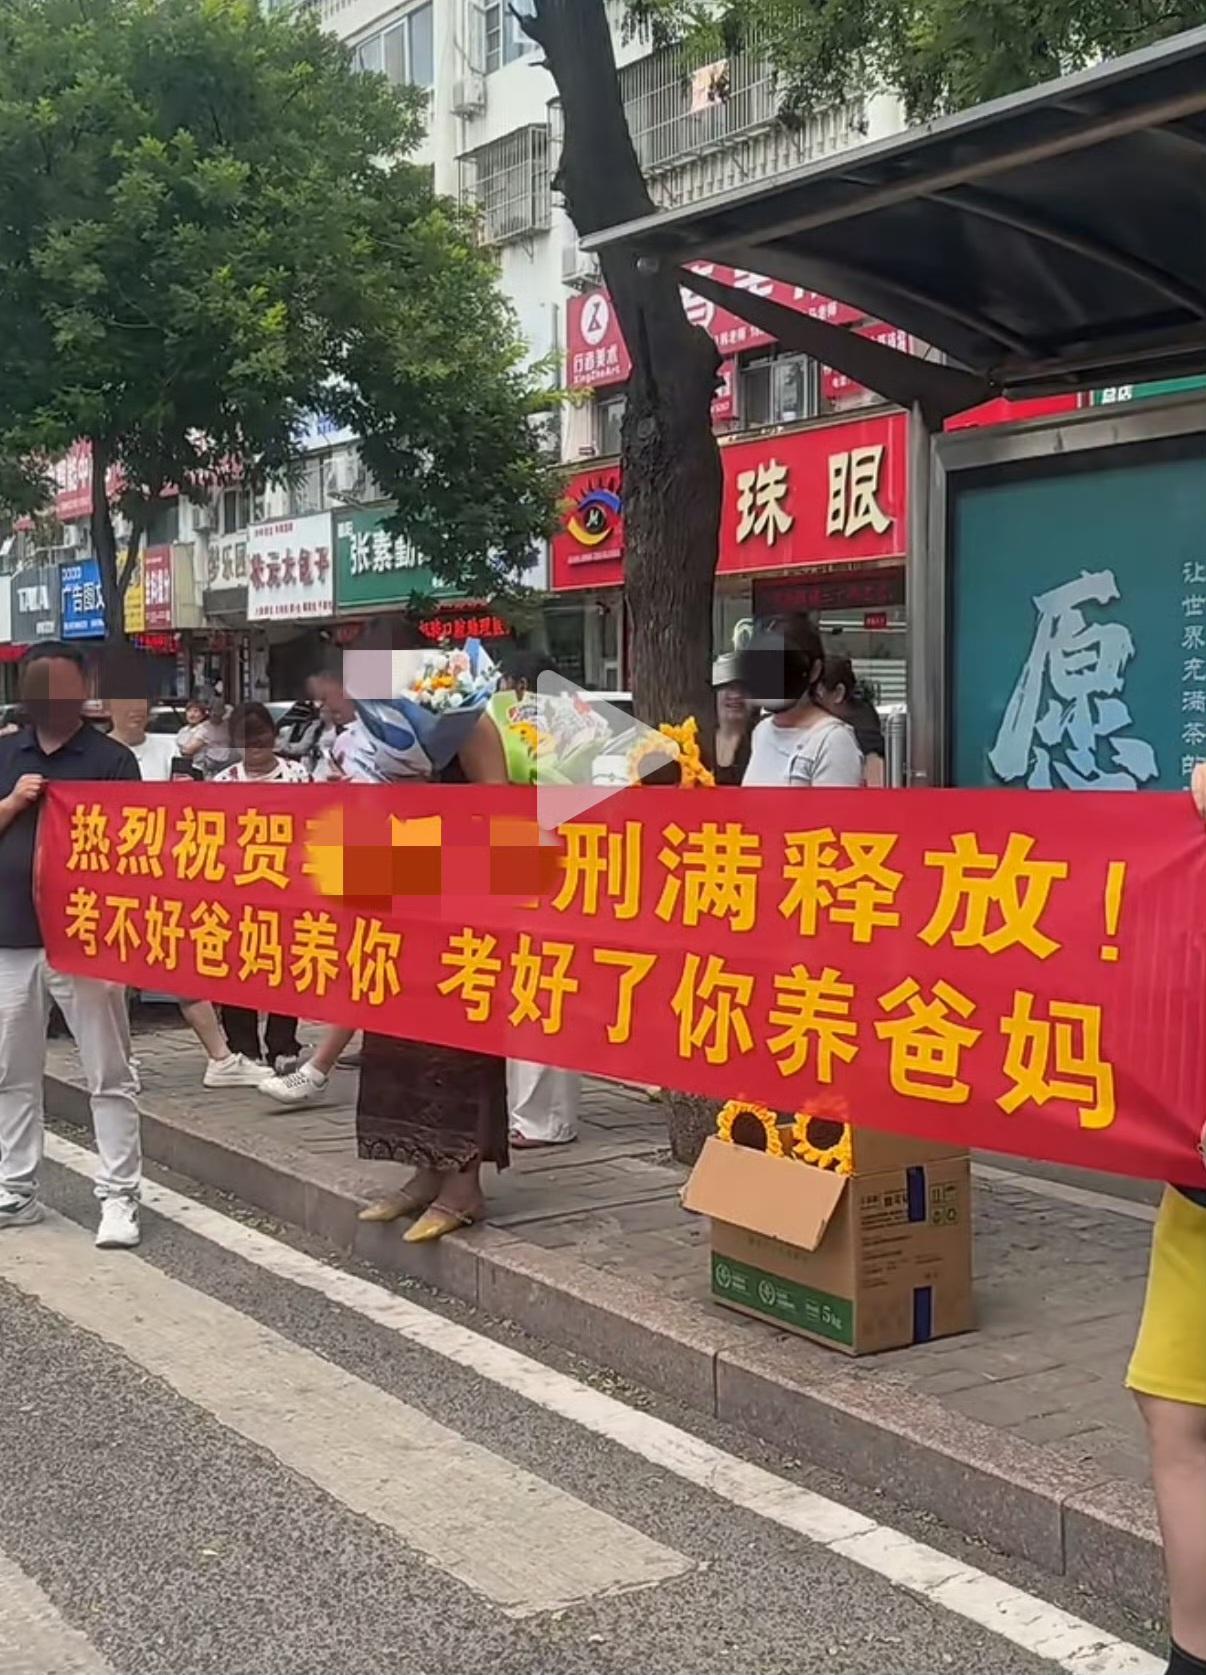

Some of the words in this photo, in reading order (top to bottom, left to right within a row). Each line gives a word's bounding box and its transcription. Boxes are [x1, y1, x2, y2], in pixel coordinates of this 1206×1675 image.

[988, 569, 1159, 791] 愿
[65, 803, 294, 891] 热烈祝贺
[64, 886, 402, 1007] 考不好爸妈养你
[436, 926, 1118, 1131] 考好了你养爸妈
